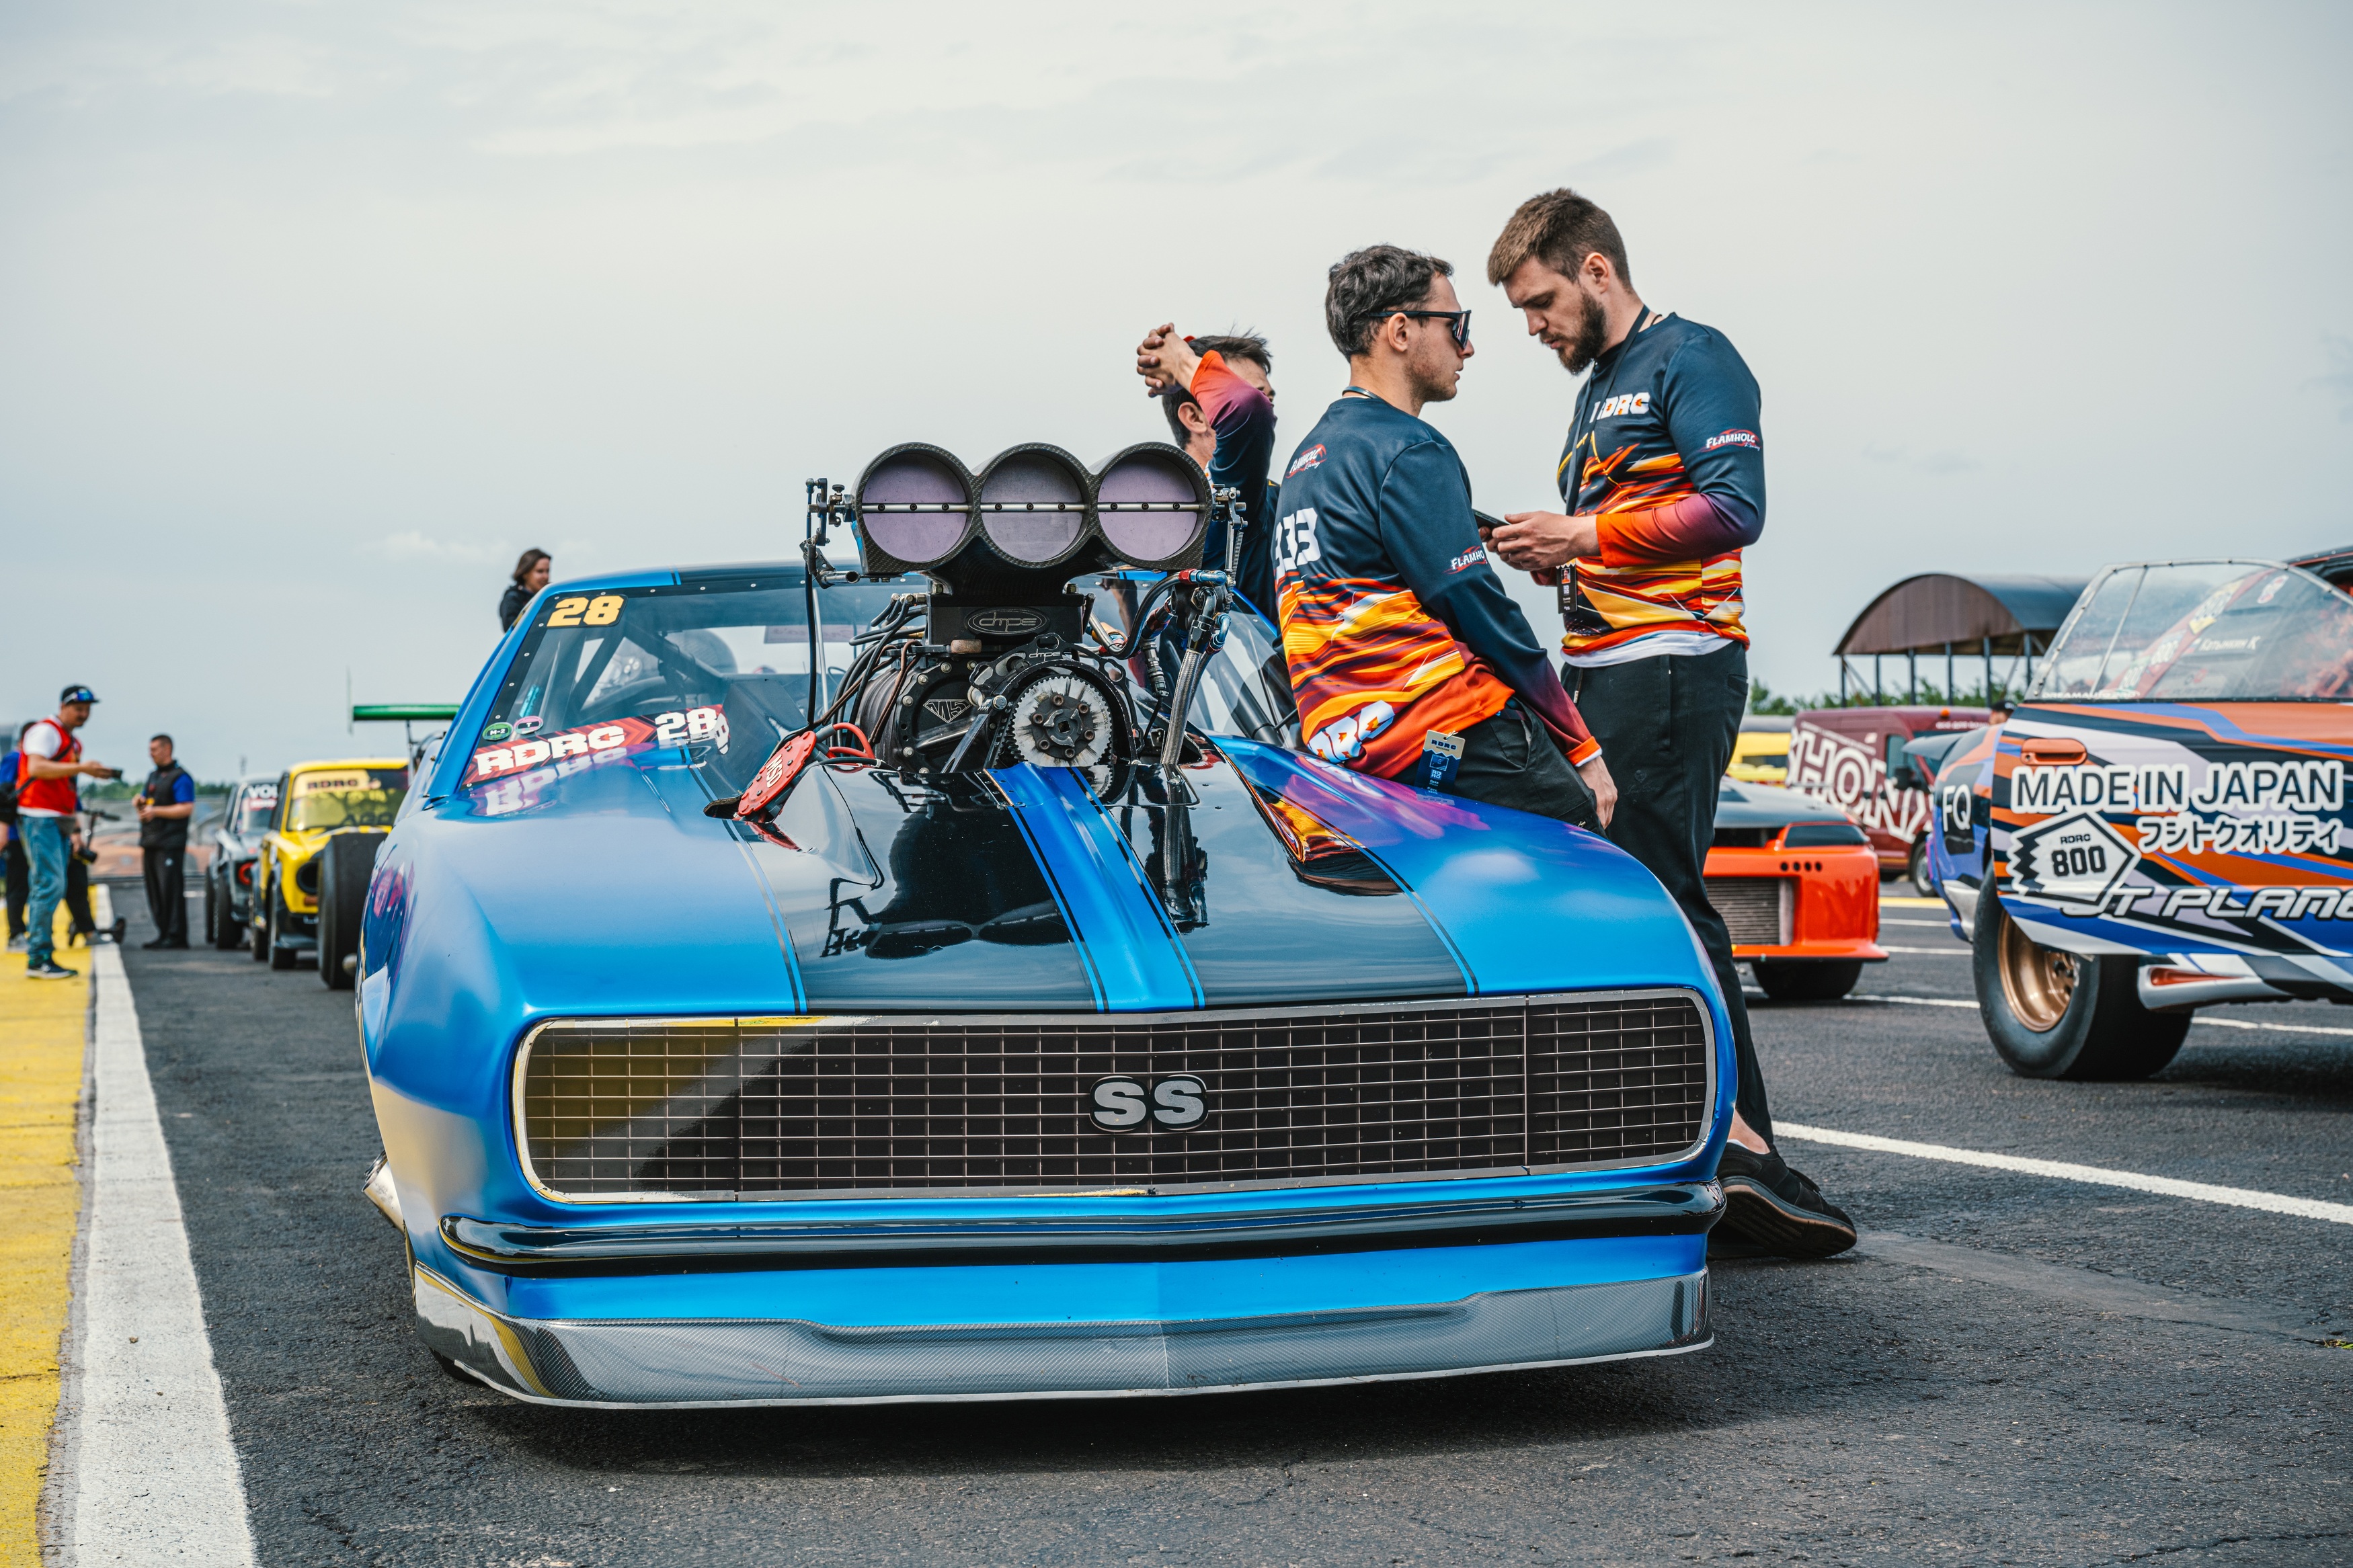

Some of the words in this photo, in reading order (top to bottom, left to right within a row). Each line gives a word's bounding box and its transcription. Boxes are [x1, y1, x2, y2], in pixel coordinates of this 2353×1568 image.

[546, 595, 626, 628] 28
[489, 728, 506, 736] M-2
[654, 707, 717, 743] 28
[473, 725, 625, 776] RDRC
[1431, 739, 1457, 750] RDRC
[766, 753, 784, 789] MSD
[2017, 772, 2130, 807] MADE
[2144, 770, 2183, 805] IN
[2198, 768, 2336, 804] JAPAN
[1942, 784, 1972, 832] FQ
[2060, 833, 2091, 845] RDRC
[2051, 845, 2106, 877] 800
[1092, 1079, 1205, 1127] SS
